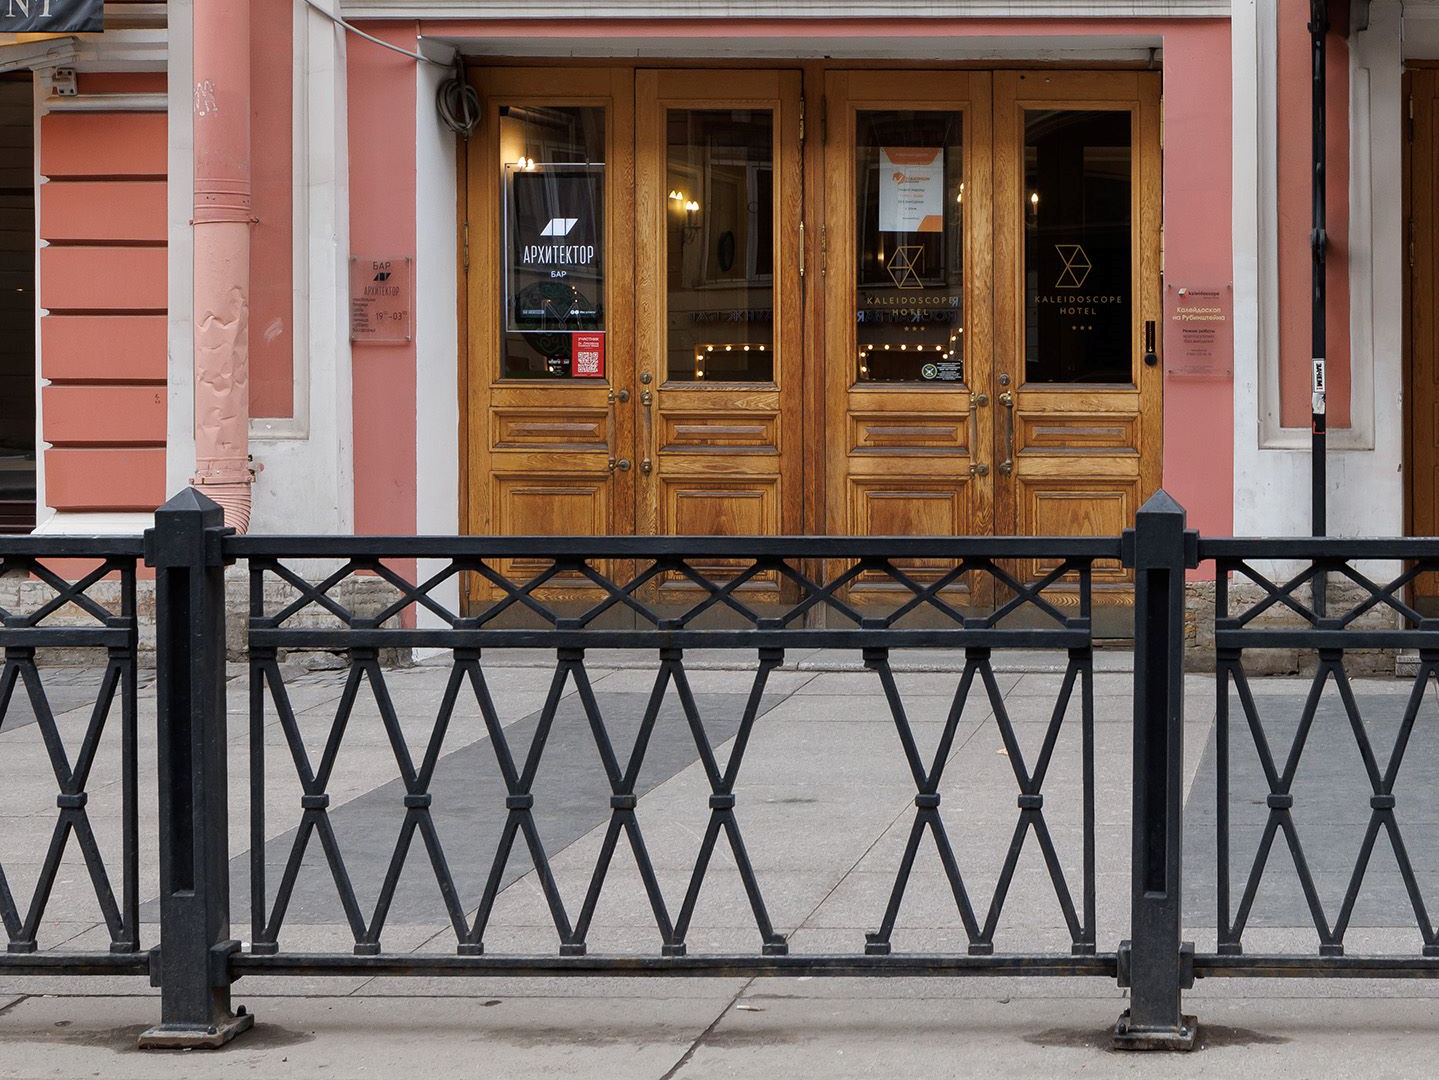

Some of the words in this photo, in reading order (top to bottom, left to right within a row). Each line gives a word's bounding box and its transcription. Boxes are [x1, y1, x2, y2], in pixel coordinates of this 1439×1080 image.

[523, 245, 594, 264] АРХИТЕКТОР
[372, 261, 391, 270] БАР
[550, 270, 567, 278] БАР
[364, 286, 400, 296] АРХИТЕКТОР
[866, 296, 954, 305] KALEIDOSCOPE
[1034, 295, 1122, 304] KALEIDOSCOPE
[892, 308, 929, 316] HOTEL
[1060, 307, 1097, 315] HOTEL
